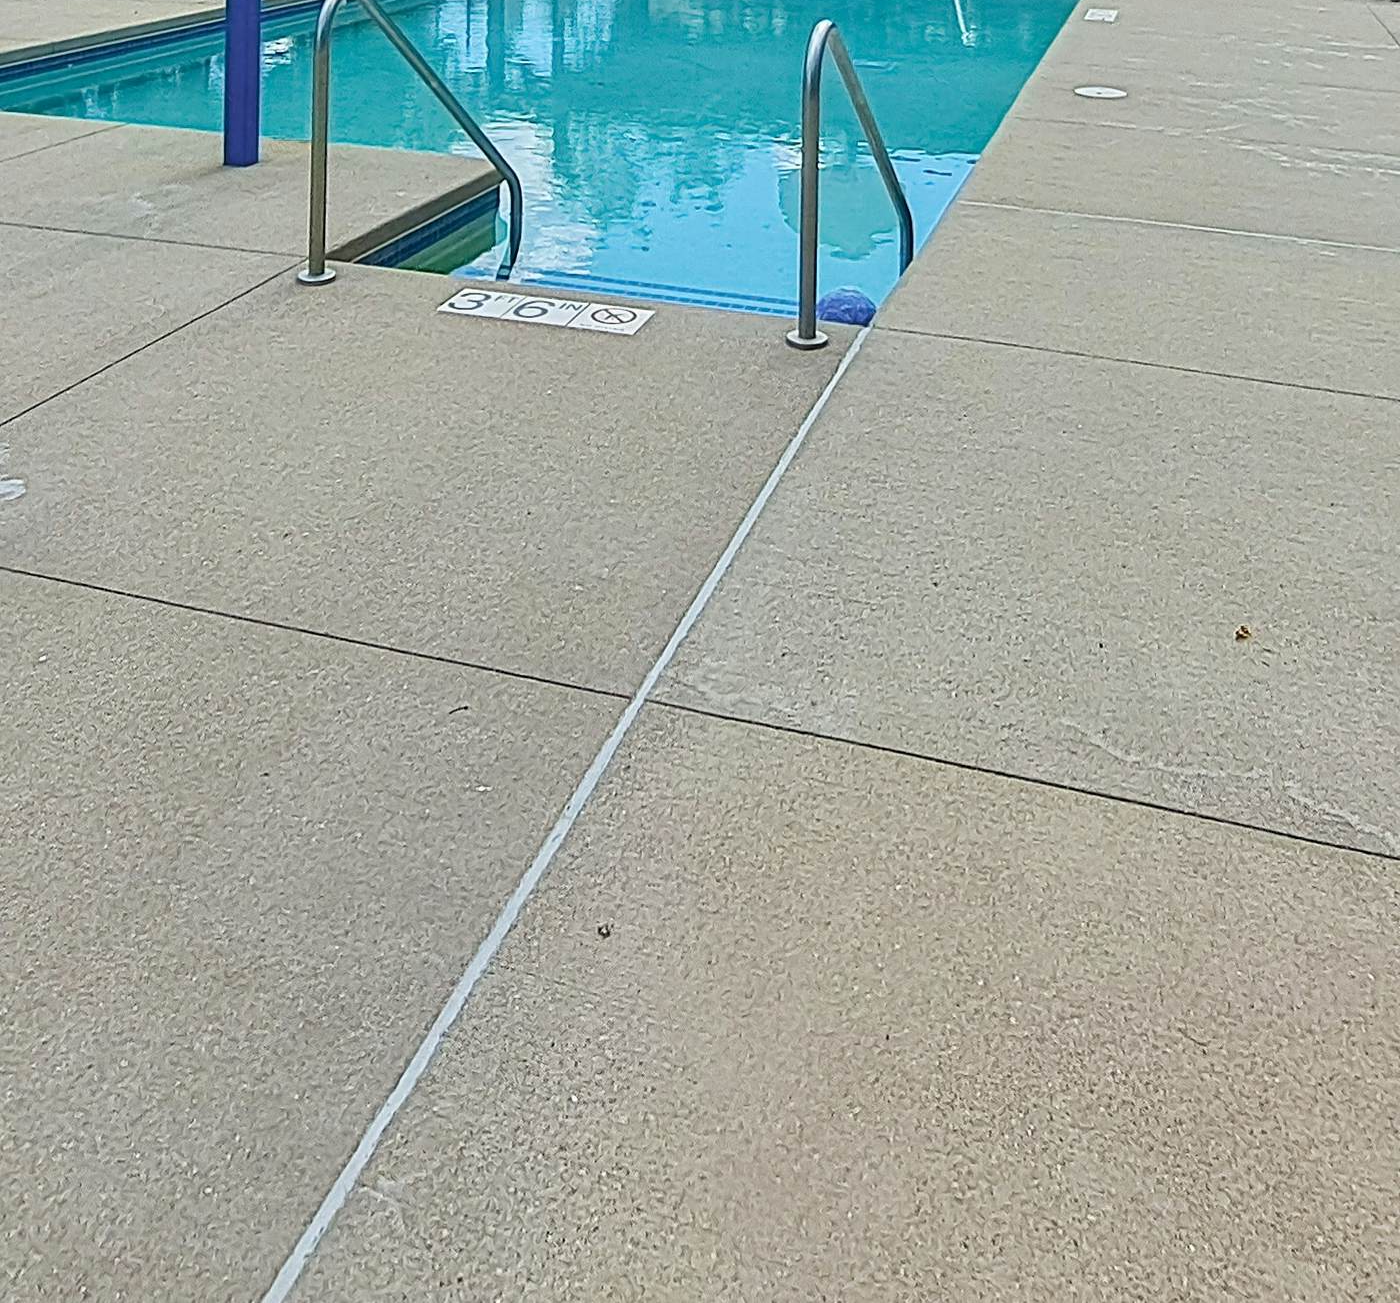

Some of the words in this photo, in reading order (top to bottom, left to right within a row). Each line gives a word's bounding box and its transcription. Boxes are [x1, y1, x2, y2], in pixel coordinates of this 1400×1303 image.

[448, 293, 491, 310] 3
[495, 295, 519, 303] FT
[513, 299, 555, 318] 6
